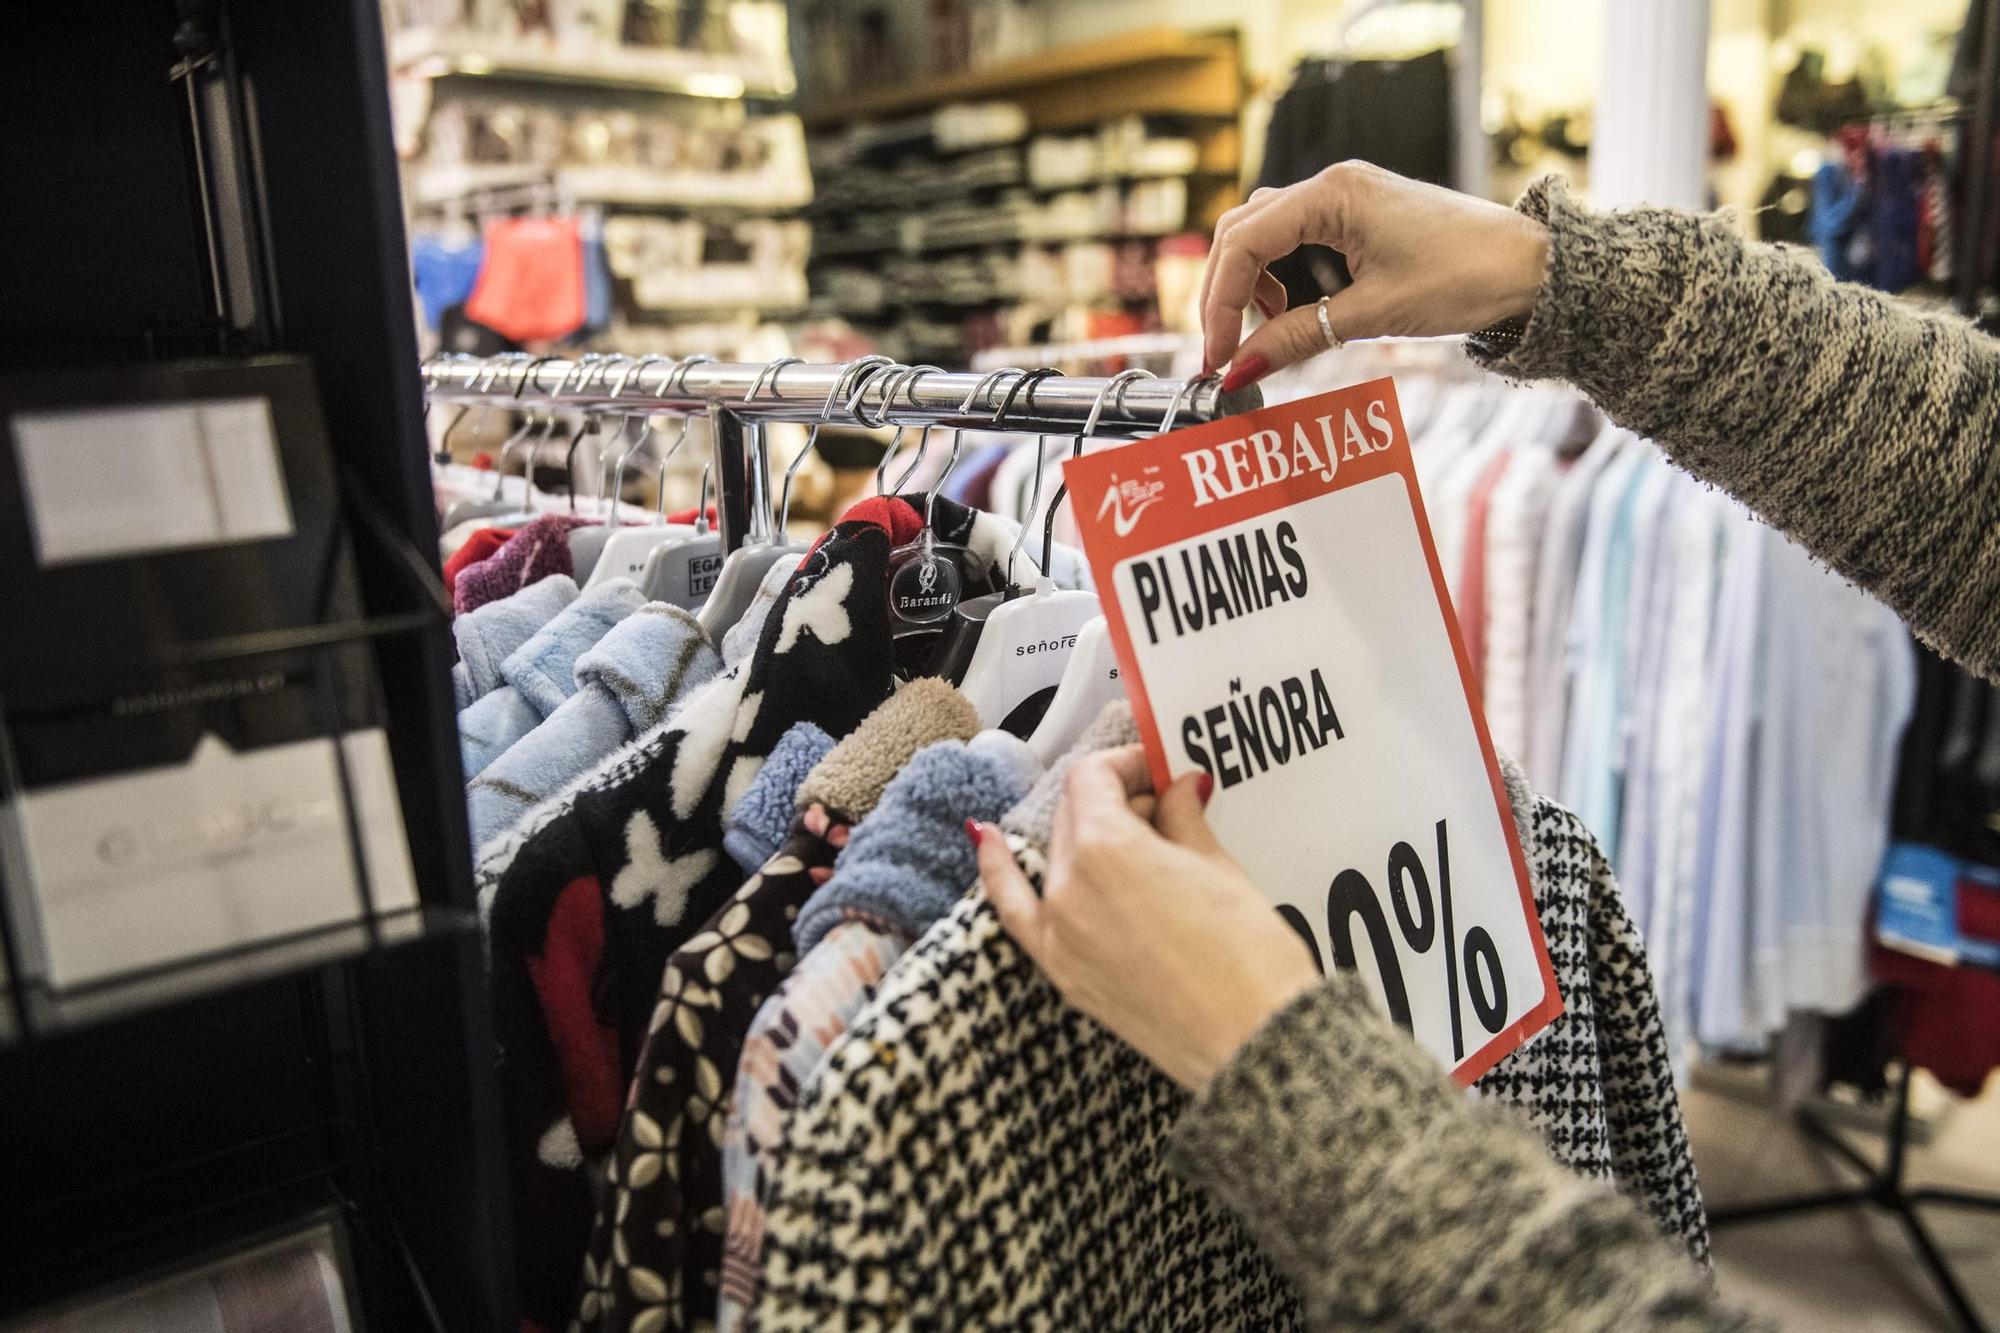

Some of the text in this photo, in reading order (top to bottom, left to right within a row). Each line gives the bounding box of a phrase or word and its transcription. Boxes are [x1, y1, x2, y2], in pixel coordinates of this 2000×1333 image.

[1181, 399, 1394, 507] REBAJAS
[693, 575, 719, 591] TE
[1130, 520, 1308, 645] PIJAMAS
[1016, 634, 1078, 656] señore
[1182, 667, 1345, 791] SEÑORA
[1275, 818, 1508, 1063] 0%
